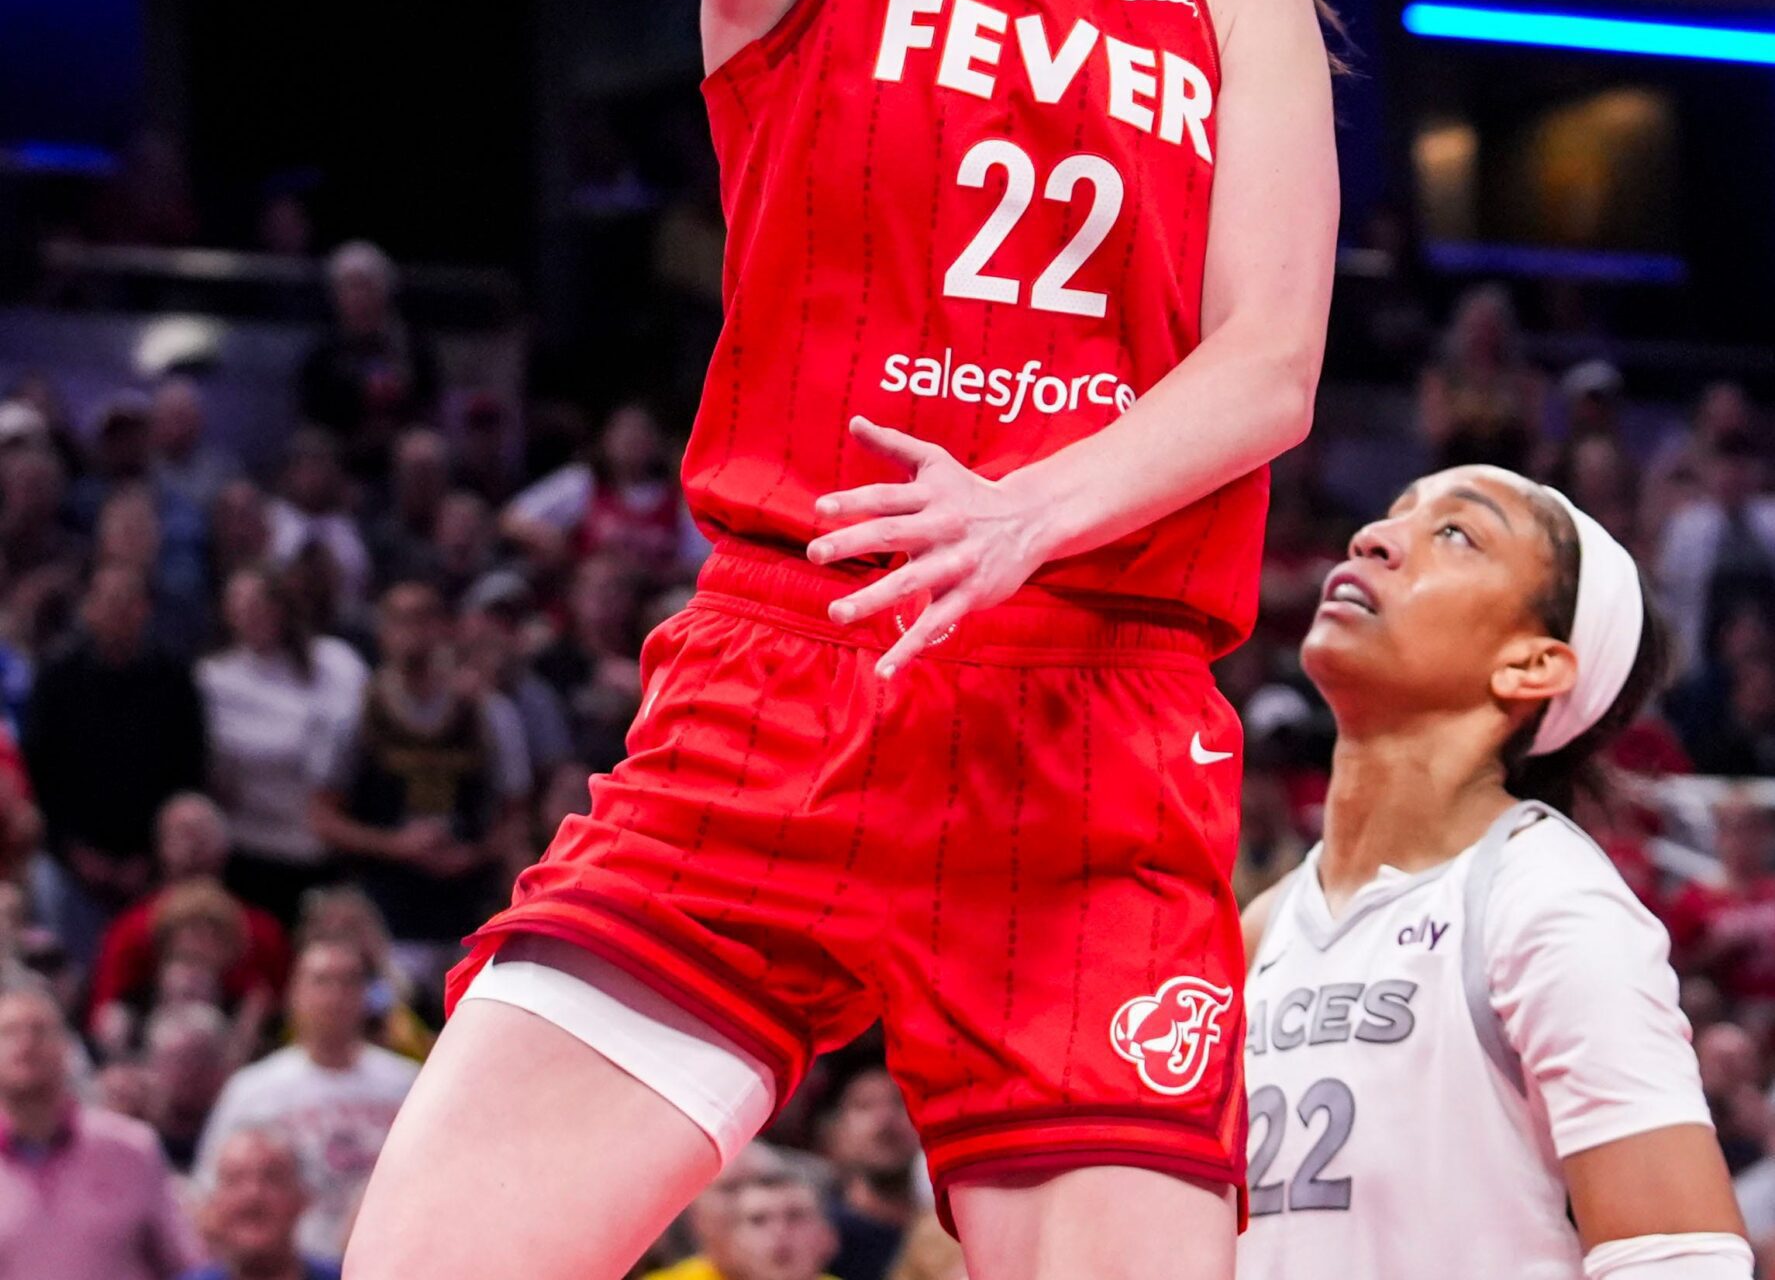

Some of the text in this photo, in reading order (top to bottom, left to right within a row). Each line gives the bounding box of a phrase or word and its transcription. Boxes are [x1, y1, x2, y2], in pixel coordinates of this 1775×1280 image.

[942, 138, 1125, 319] 22
[879, 347, 1137, 423] salesforce
[1247, 1077, 1356, 1218] 22
